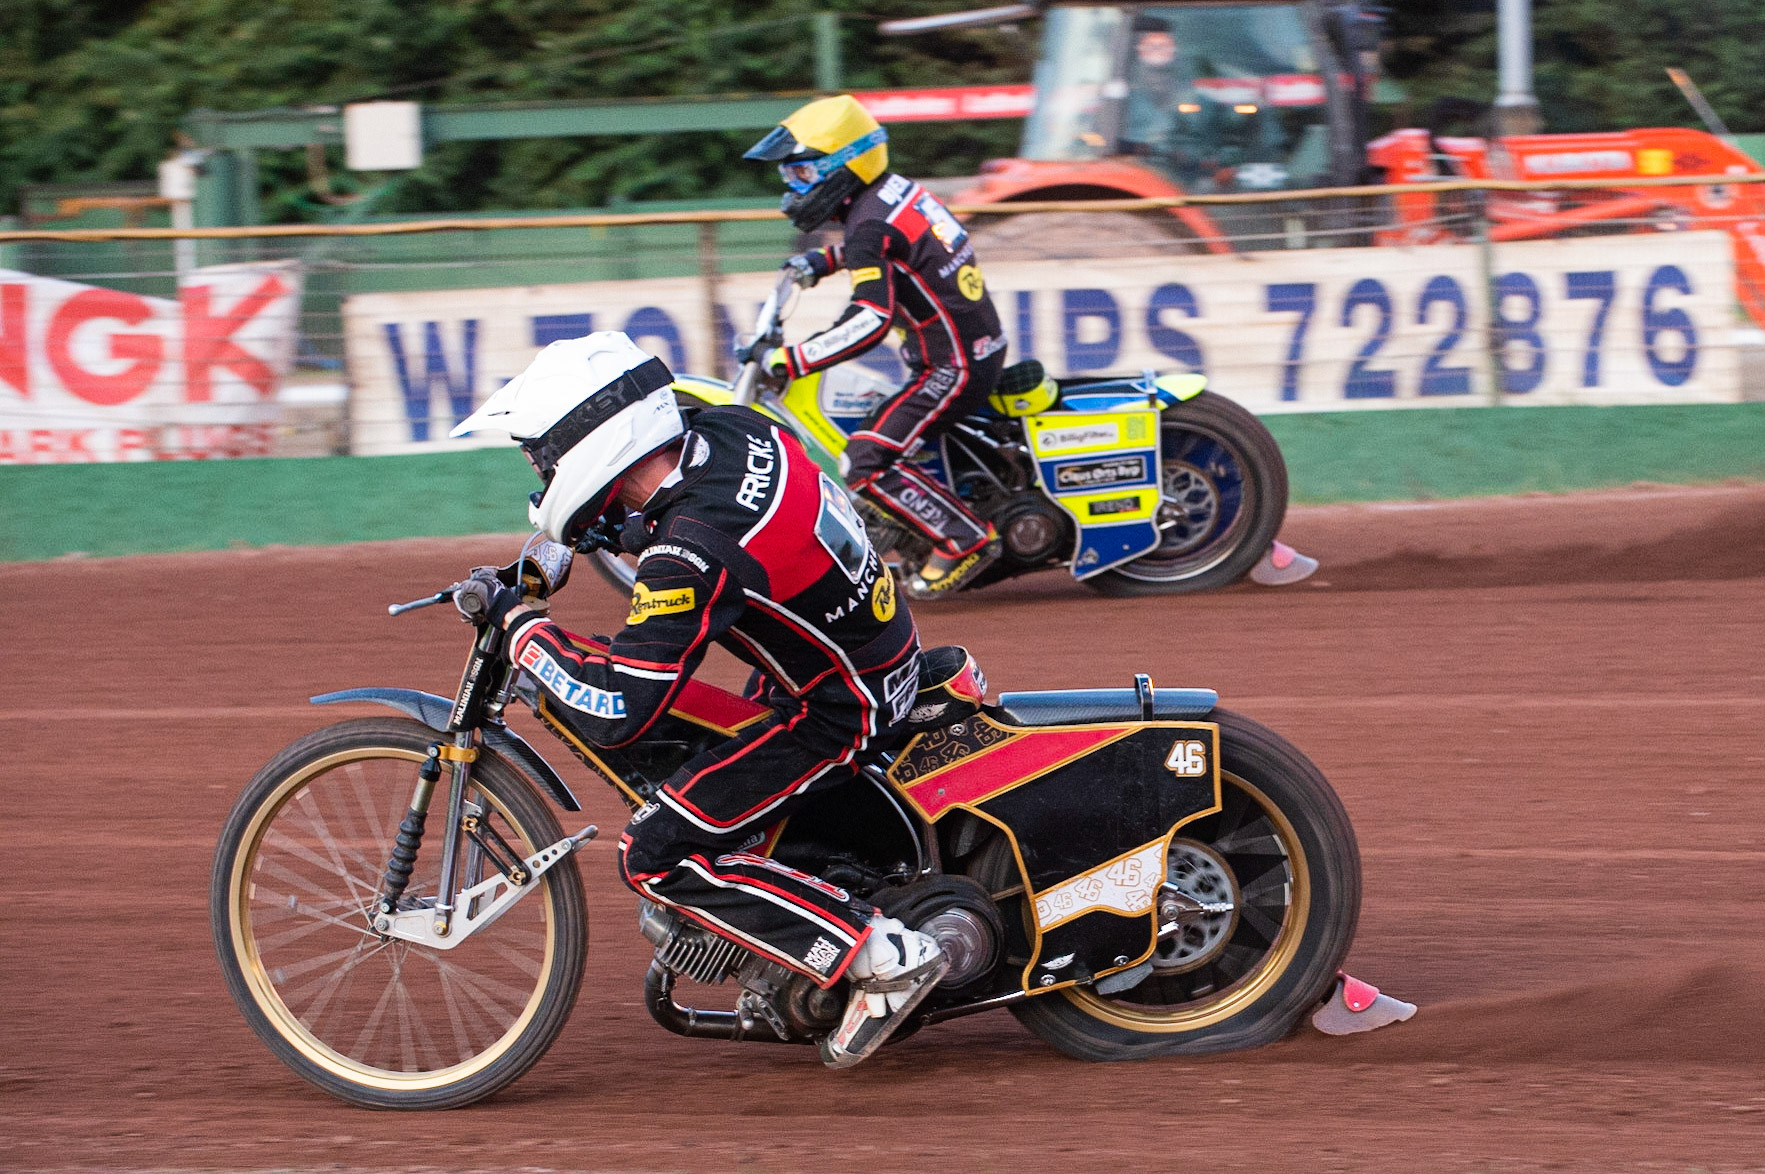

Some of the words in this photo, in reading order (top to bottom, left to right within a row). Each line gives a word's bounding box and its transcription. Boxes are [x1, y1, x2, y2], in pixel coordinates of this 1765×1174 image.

[0, 271, 294, 406] GK
[1265, 263, 1699, 402] 722876
[735, 433, 774, 512] FRICKE
[539, 658, 627, 716] BETARD
[1164, 740, 1206, 777] 46
[1105, 857, 1143, 887] 46
